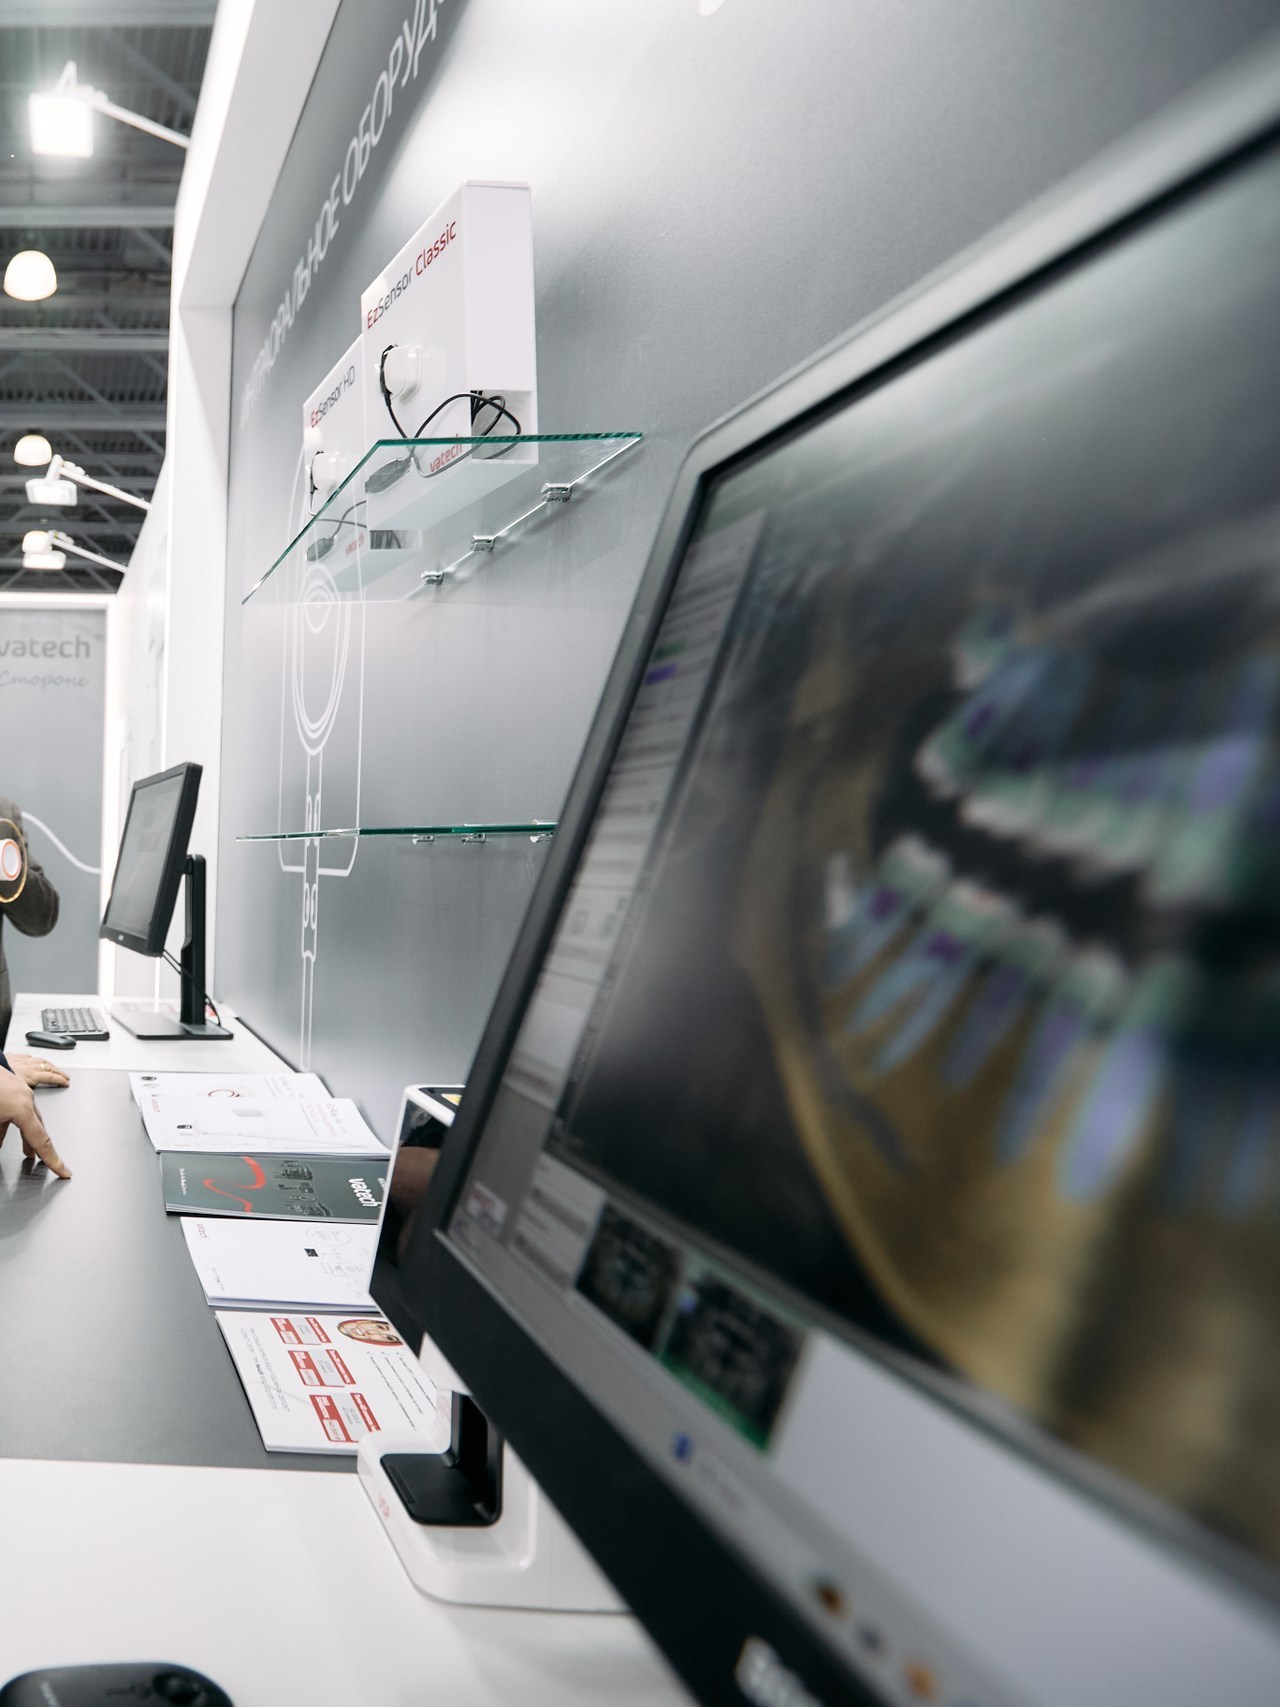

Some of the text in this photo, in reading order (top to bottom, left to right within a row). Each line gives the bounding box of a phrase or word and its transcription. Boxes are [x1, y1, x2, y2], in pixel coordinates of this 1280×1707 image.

[342, 0, 444, 206] ОБОРУД
[366, 220, 457, 330] EzSensor Classic
[310, 364, 356, 429] EzSensor HD
[429, 433, 463, 473] vatech
[349, 1177, 383, 1207] vatech
